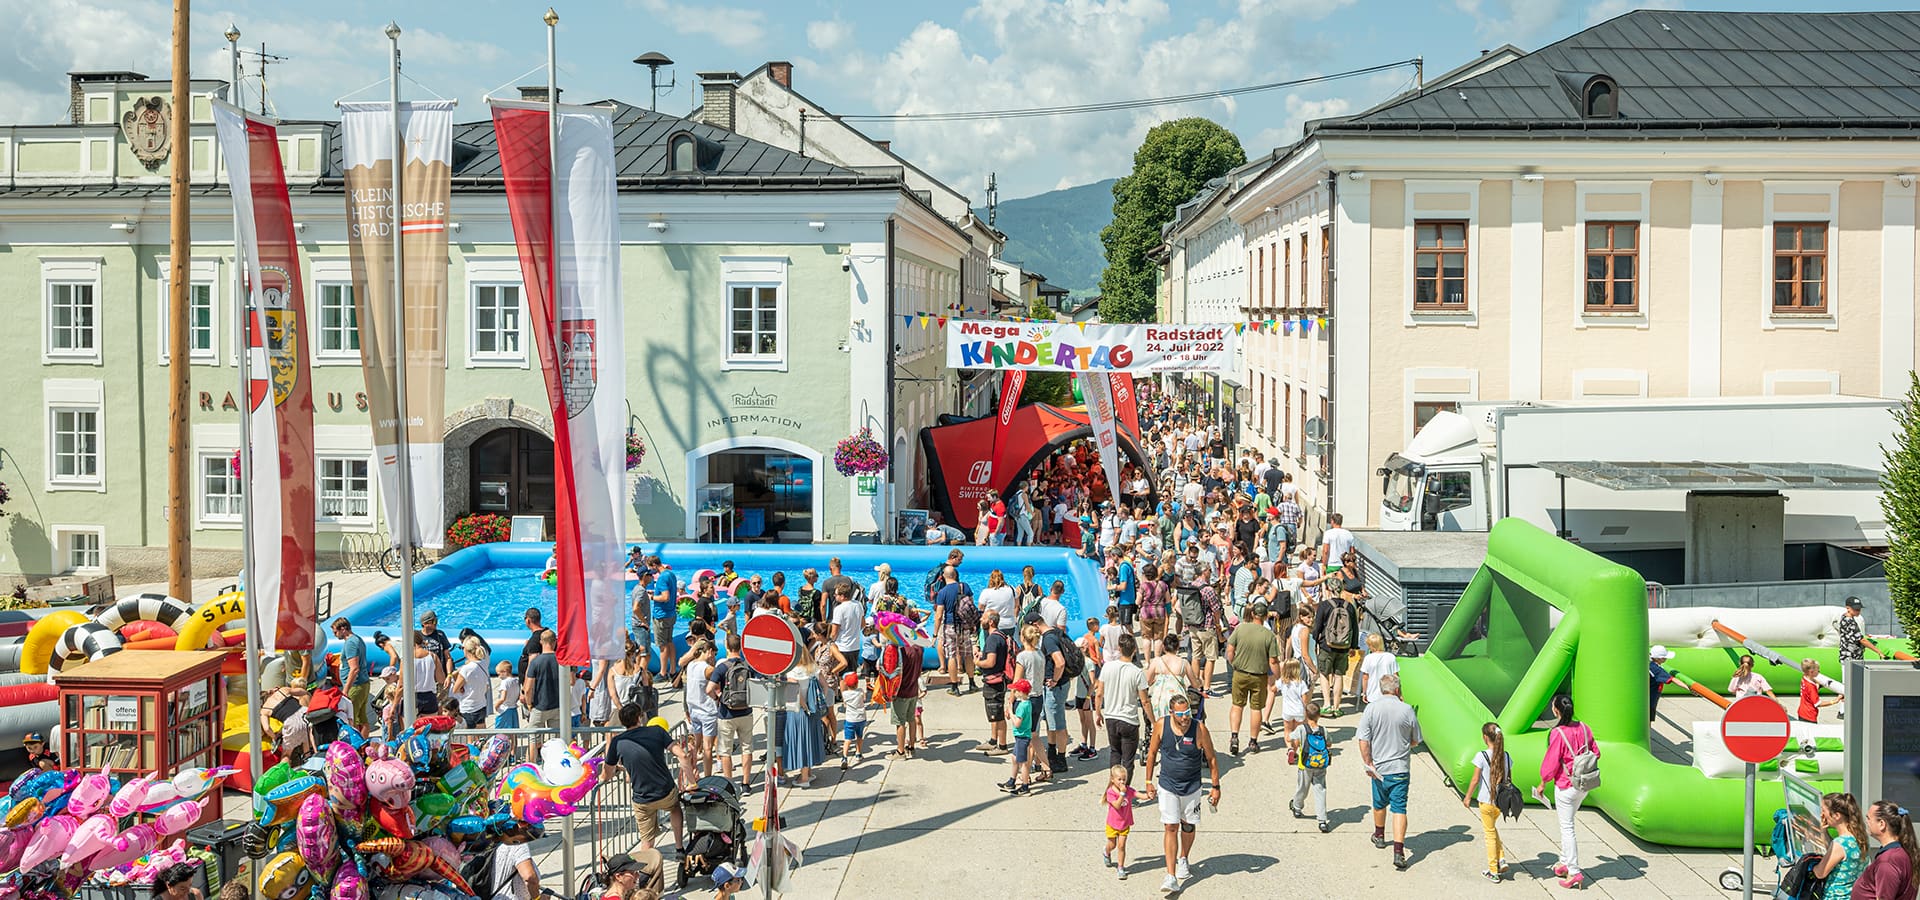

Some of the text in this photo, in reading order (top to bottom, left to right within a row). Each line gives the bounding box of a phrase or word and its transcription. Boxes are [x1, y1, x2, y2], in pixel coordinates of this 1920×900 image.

[351, 188, 393, 203] KLEIN
[352, 202, 445, 220] HISTOISCHE
[961, 323, 1020, 338] Mega
[1146, 328, 1223, 340] Radstadt
[1146, 343, 1224, 352] 24. Juli 2022
[960, 341, 1133, 370] KINDERTAG
[199, 391, 369, 411] RAAUS
[735, 397, 775, 406] Radstadt
[707, 415, 802, 429] INFORMATION
[202, 600, 242, 622] STA
